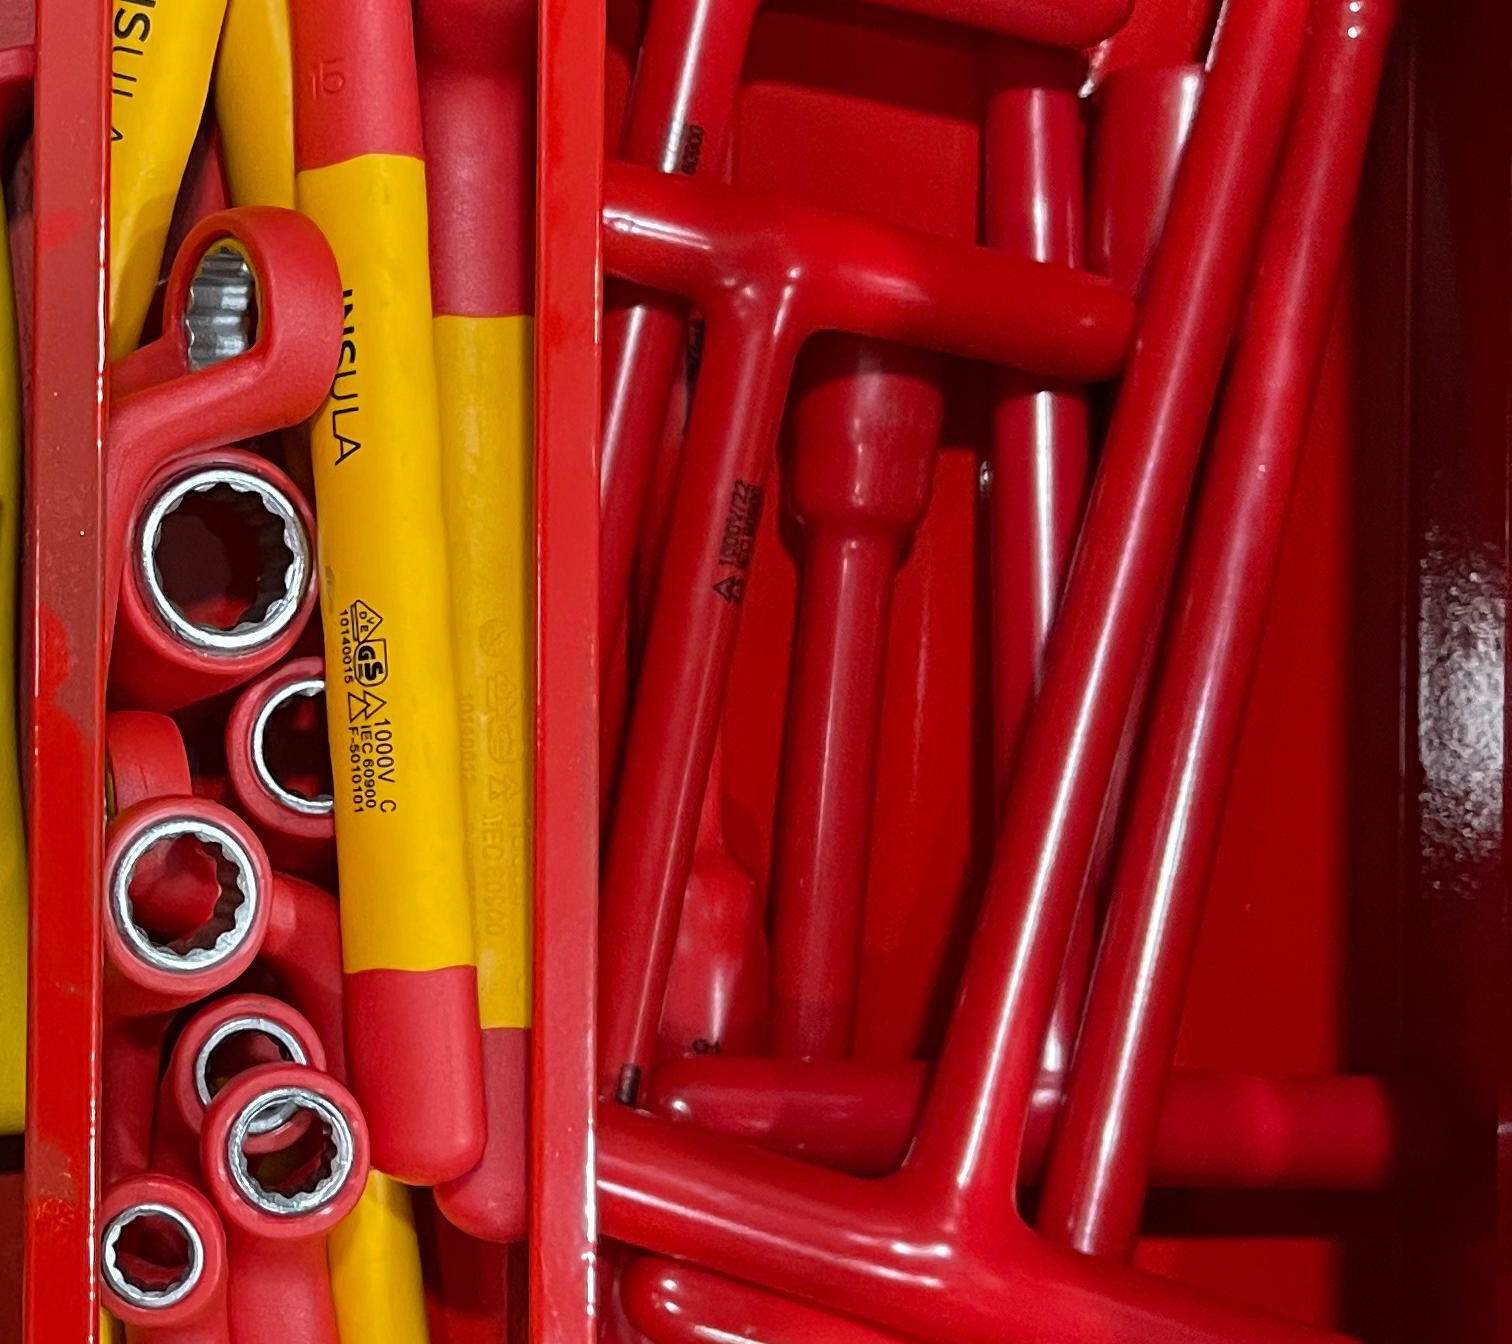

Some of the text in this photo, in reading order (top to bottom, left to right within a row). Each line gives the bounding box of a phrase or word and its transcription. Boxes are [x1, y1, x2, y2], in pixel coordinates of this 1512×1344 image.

[339, 608, 355, 685] 10140015
[348, 725, 365, 813] F-5010101
[360, 724, 377, 809] IEC 60900
[374, 717, 397, 814] 1000V C
